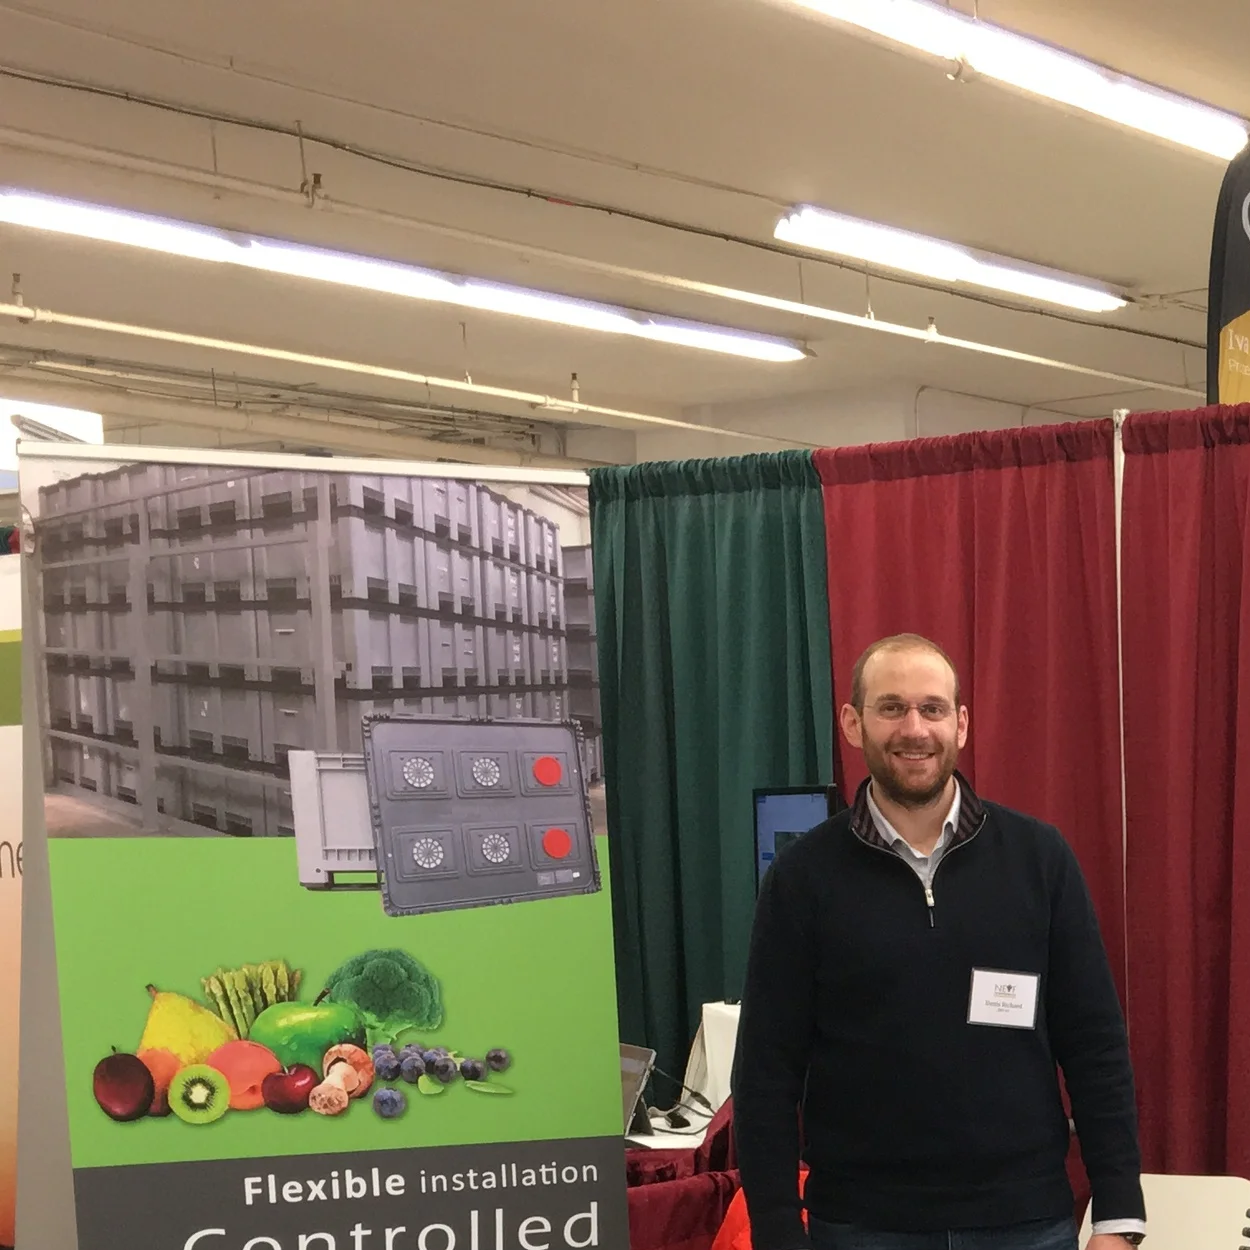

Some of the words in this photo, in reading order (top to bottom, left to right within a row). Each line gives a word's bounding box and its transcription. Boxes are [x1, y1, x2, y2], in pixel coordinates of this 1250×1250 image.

[1228, 329, 1249, 354] Iva
[244, 1167, 406, 1205] Flexible
[420, 1161, 598, 1194] installation
